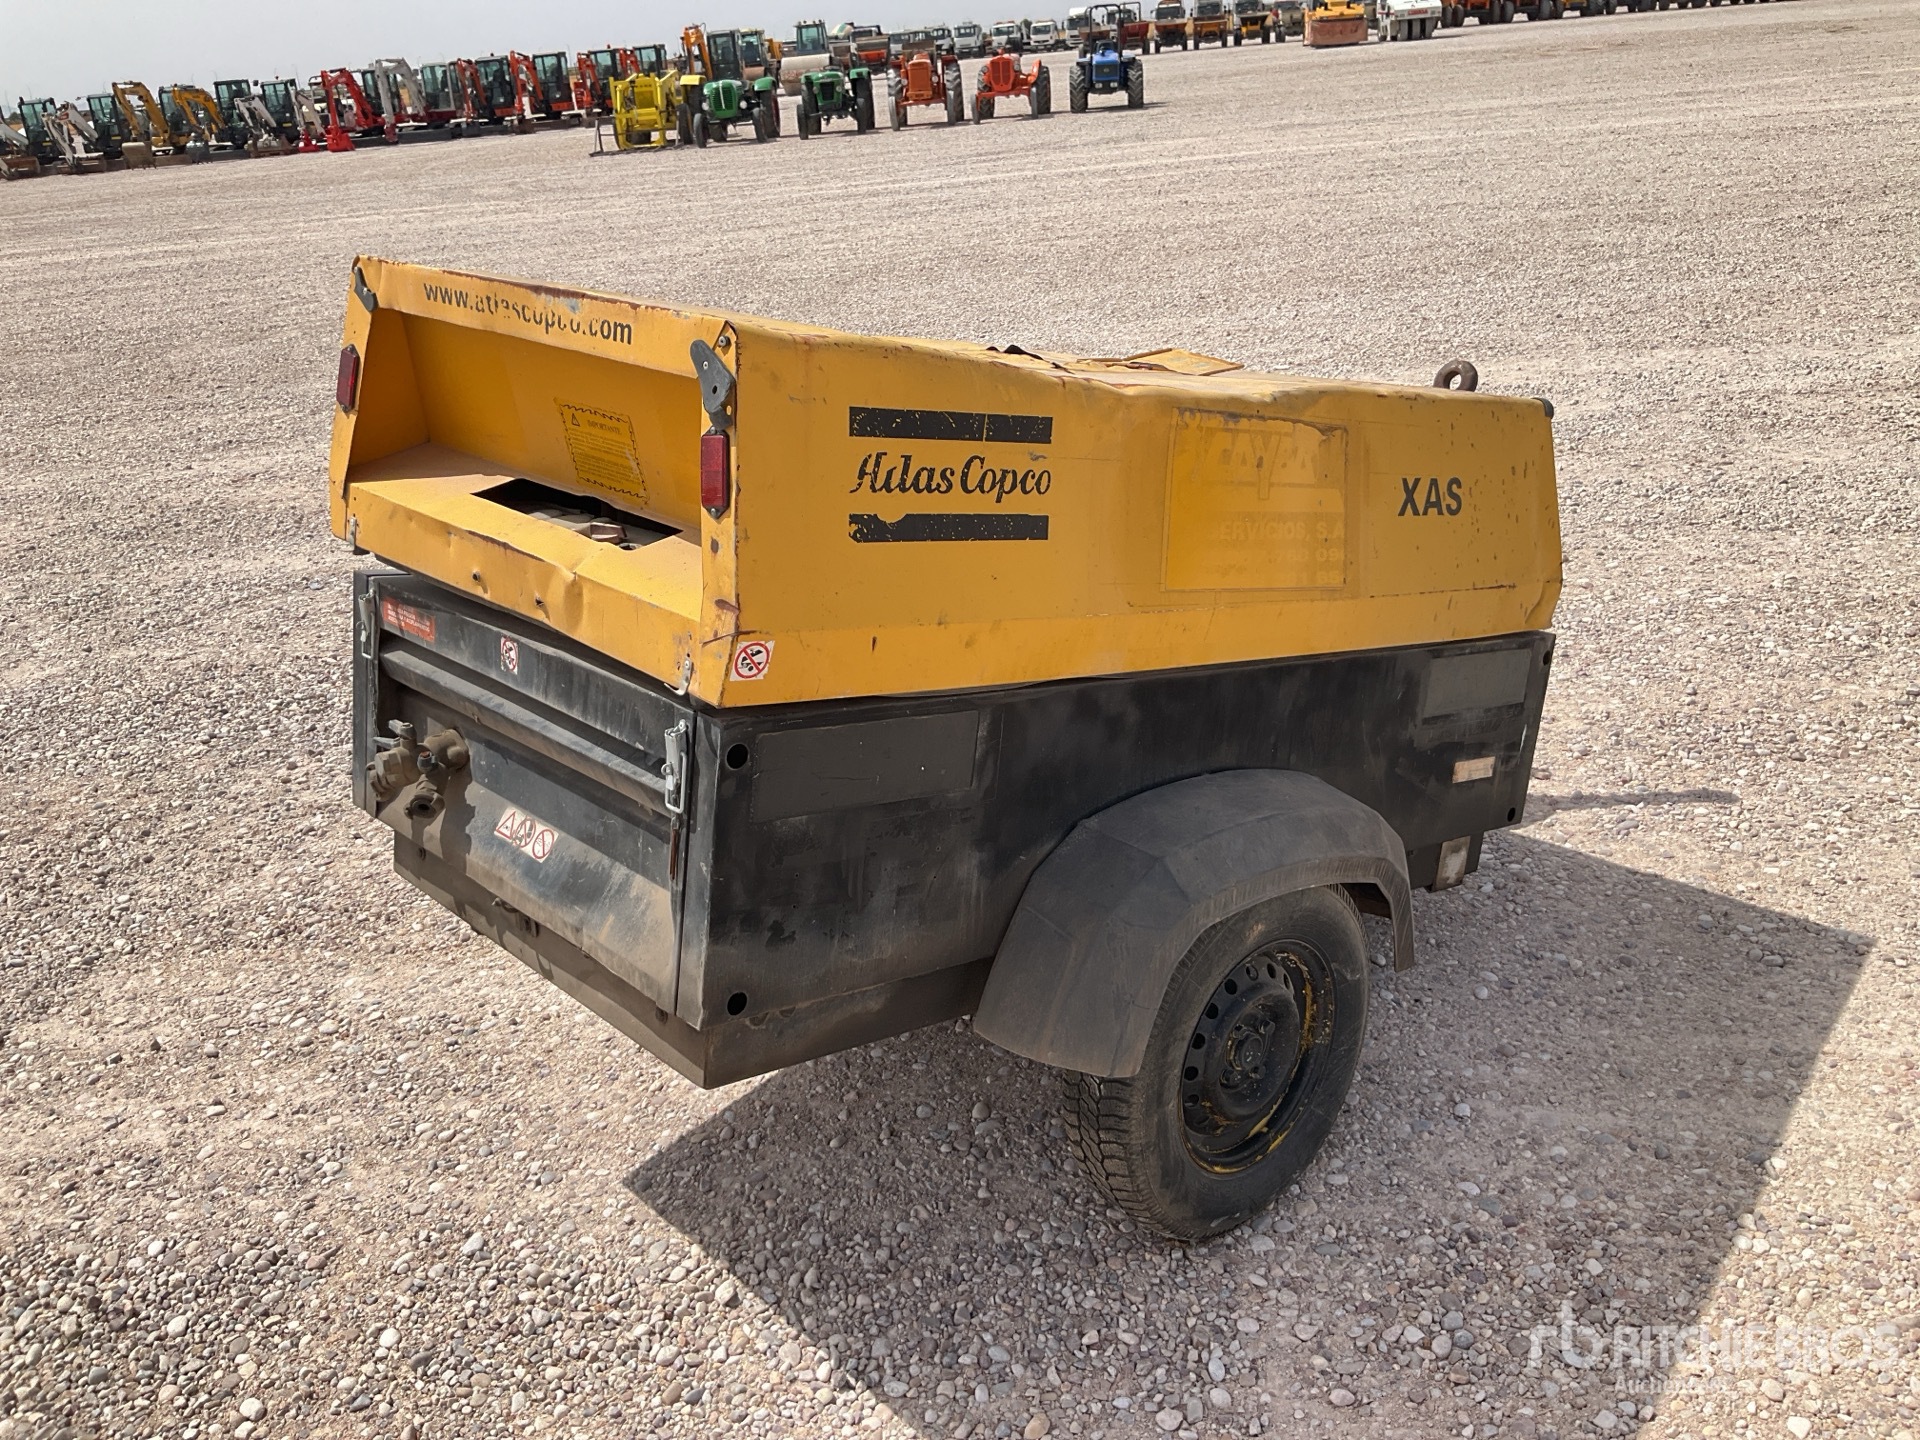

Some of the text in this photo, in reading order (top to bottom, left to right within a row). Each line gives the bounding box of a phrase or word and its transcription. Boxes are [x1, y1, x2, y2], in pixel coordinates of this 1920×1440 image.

[850, 452, 1051, 504] Atlas Copco
[1398, 477, 1462, 517] XAS
